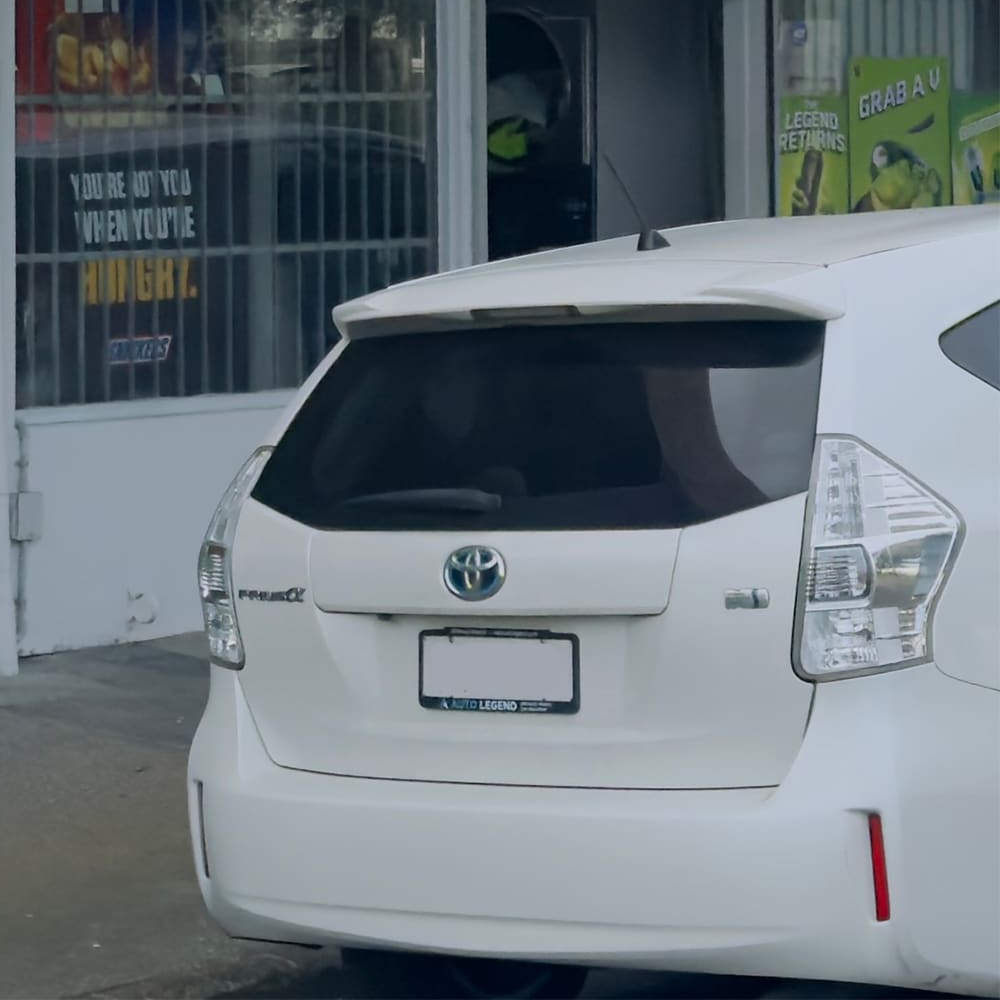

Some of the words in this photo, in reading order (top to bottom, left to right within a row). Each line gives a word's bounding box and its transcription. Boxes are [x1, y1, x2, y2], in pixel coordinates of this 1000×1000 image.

[859, 80, 907, 119] GRAB
[912, 73, 926, 99] A
[785, 111, 839, 130] LEGEND
[779, 131, 846, 153] RETURNS
[70, 170, 126, 201] YOURE
[160, 168, 192, 197] YOU
[74, 208, 128, 244] WHEN
[451, 699, 478, 710] AUTO
[479, 700, 518, 712] LEGEND
